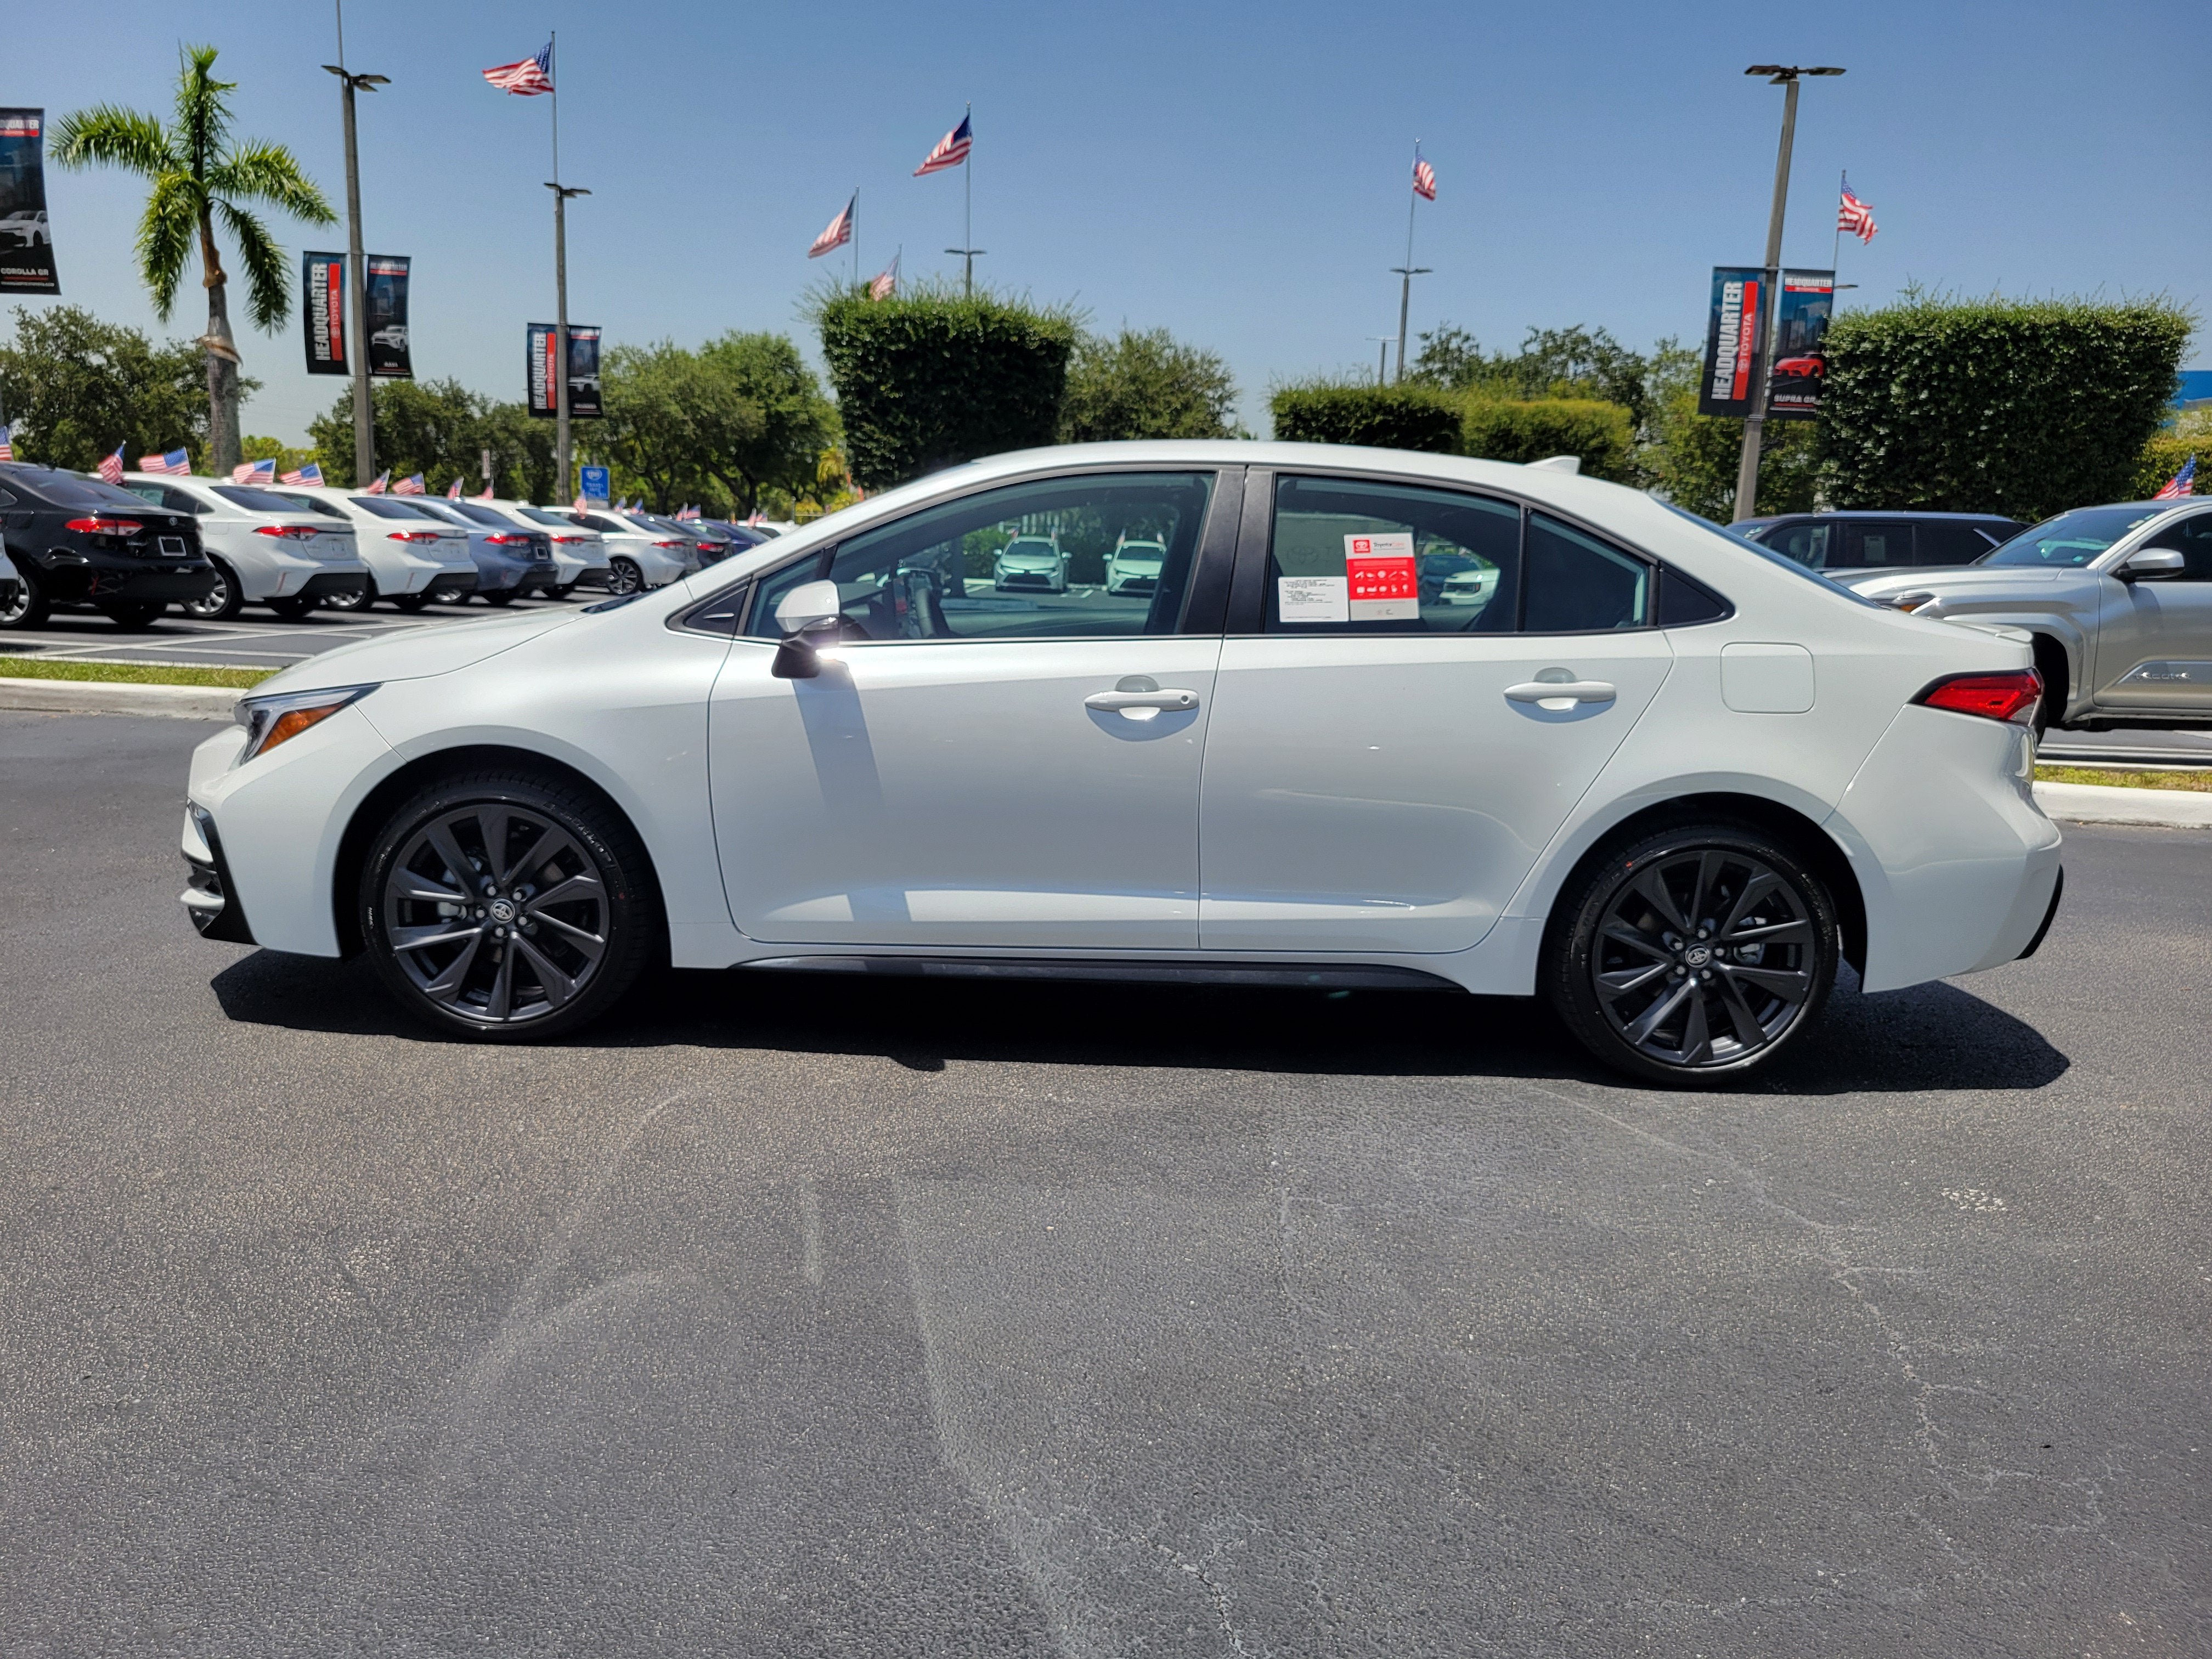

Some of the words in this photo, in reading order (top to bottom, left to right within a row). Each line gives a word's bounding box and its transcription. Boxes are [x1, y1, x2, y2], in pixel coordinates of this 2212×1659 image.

[311, 263, 330, 360] HEADQUARTER
[1711, 281, 1743, 400] HEADQUARTER
[1740, 313, 1753, 357] TOYOTA
[532, 332, 548, 409] HEADQUARTER
[1774, 394, 1802, 403] SUPRA
